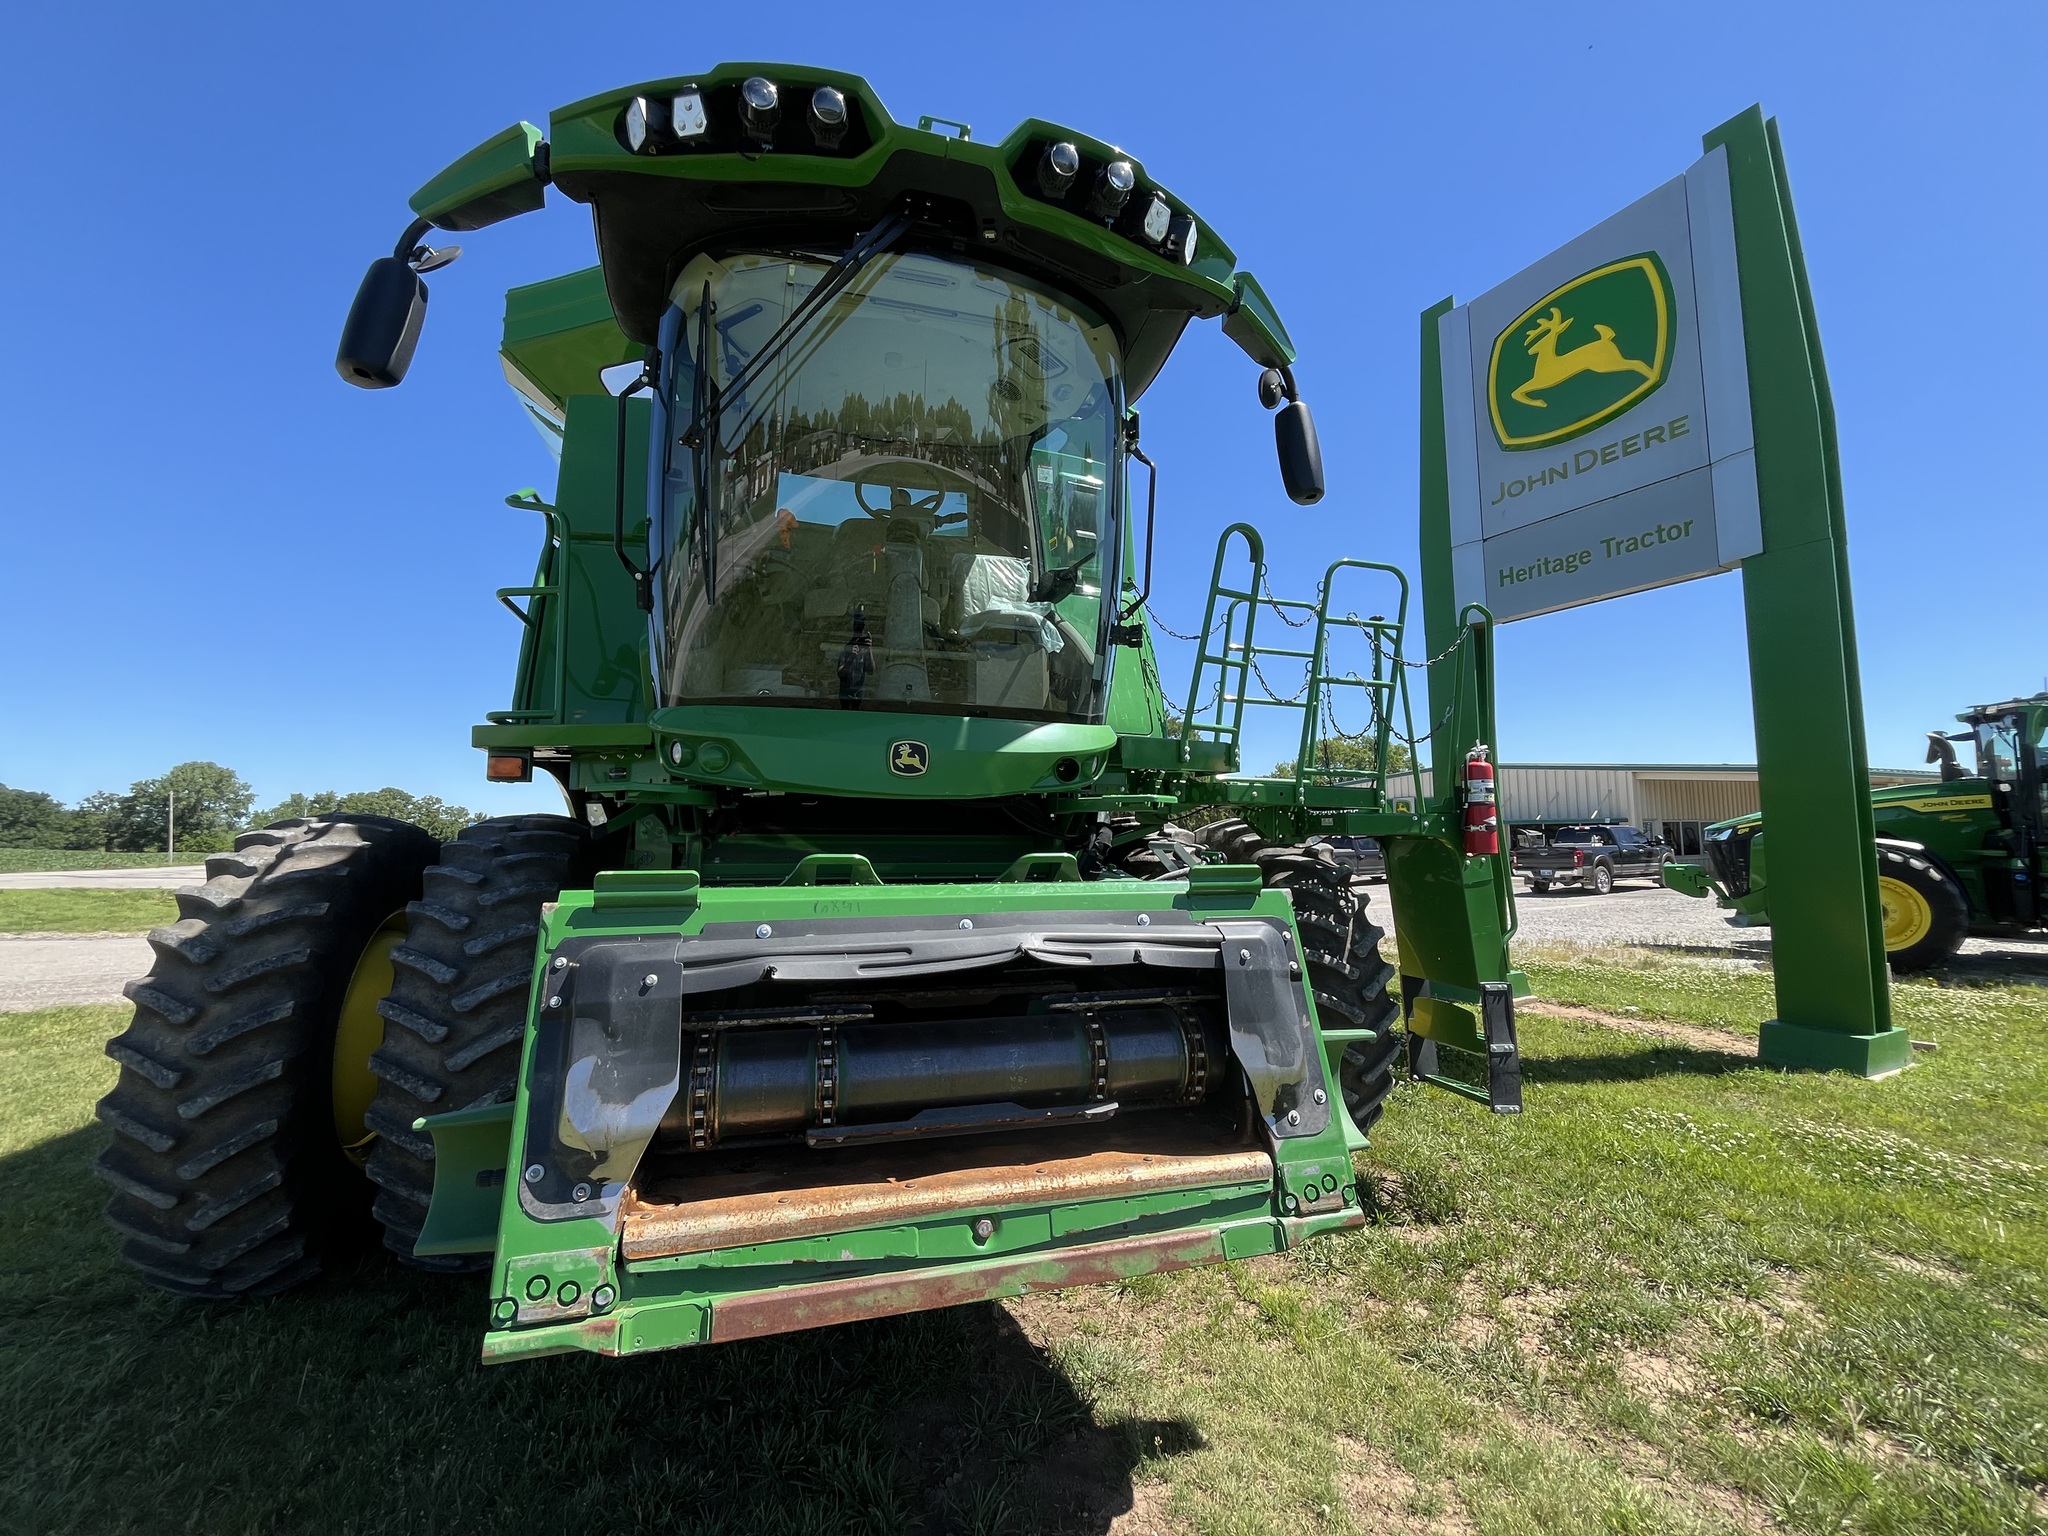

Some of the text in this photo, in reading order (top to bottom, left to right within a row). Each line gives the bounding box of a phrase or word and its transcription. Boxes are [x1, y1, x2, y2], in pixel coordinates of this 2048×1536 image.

[1491, 415, 1690, 505] JOHN DEERE
[1499, 519, 1694, 588] Heritage Tractor
[1921, 798, 1986, 809] JOHN DEERE
